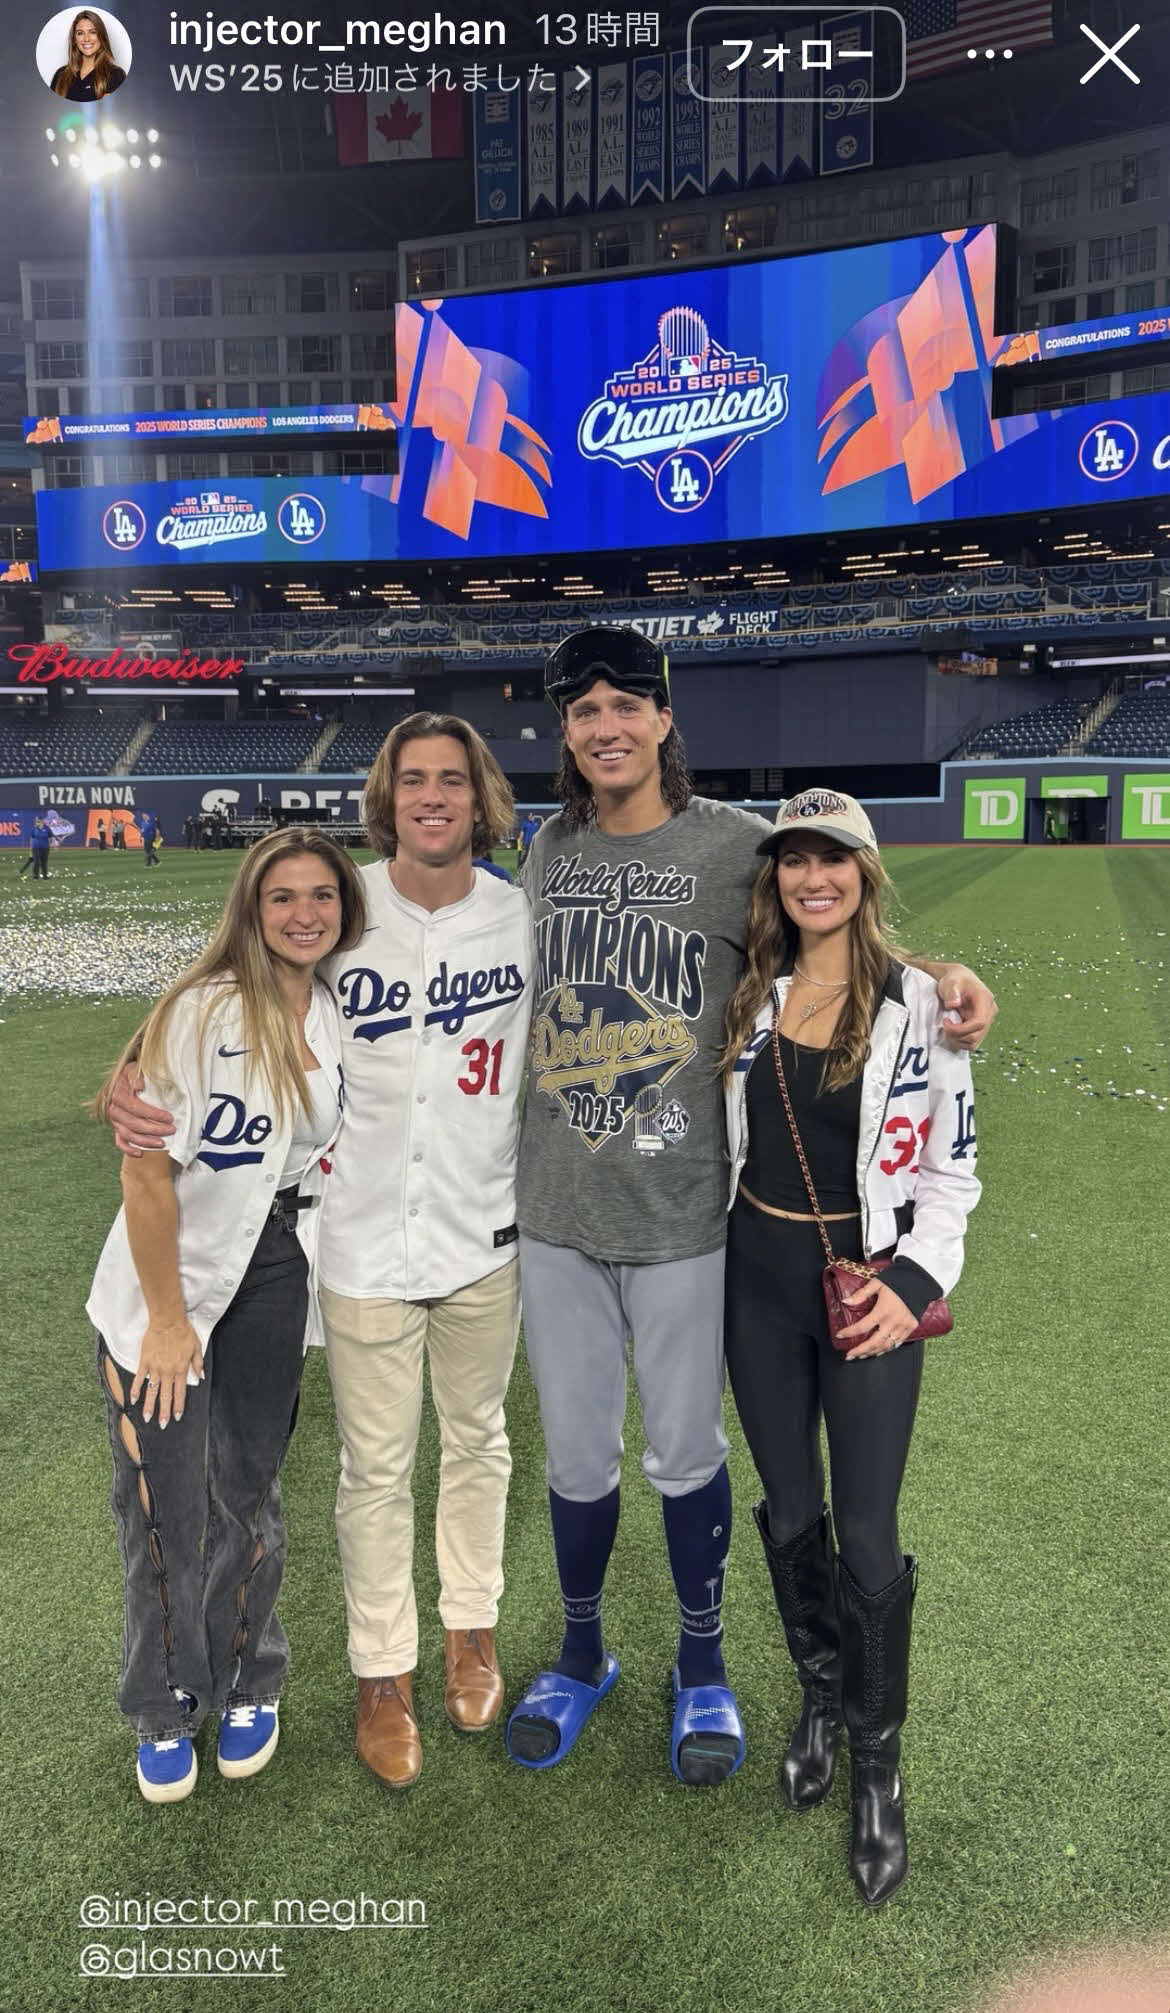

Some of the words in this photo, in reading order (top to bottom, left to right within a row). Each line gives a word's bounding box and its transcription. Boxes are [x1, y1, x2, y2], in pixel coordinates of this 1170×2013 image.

[675, 99, 701, 122] 1993
[824, 78, 870, 120] 32
[600, 113, 624, 134] 1991
[636, 107, 661, 129] 1992
[530, 121, 555, 143] 1985
[1045, 326, 1131, 350] CONGRATULATIONS
[1138, 319, 1167, 336] 2025
[637, 365, 660, 379] 20
[709, 358, 732, 371] 25
[610, 377, 681, 398] WORLD
[687, 369, 761, 391] SERIES
[64, 423, 130, 435] CONGRATULATIONS
[135, 421, 157, 433] 2025
[156, 420, 188, 432] WORLD
[188, 418, 216, 431] SERIES
[216, 416, 267, 430] CHAMPIONS
[272, 416, 286, 427] LOS
[287, 415, 319, 426] ANGELES
[319, 414, 354, 425] DODGERS
[581, 381, 786, 451] Champions
[170, 503, 210, 515] WORLD
[156, 511, 268, 546] Champions
[729, 610, 779, 625] FLIGHT
[735, 623, 772, 635] DECK
[7, 641, 244, 683] Budweiser
[38, 785, 86, 806] PIZZA
[91, 785, 136, 806] NOVA
[970, 790, 1018, 826] TD
[534, 907, 708, 1021] HAMPIONS
[532, 1008, 697, 1095] Dodgers
[457, 1037, 505, 1096] 31
[568, 1091, 625, 1134] 2025
[662, 1110, 686, 1133] WS
